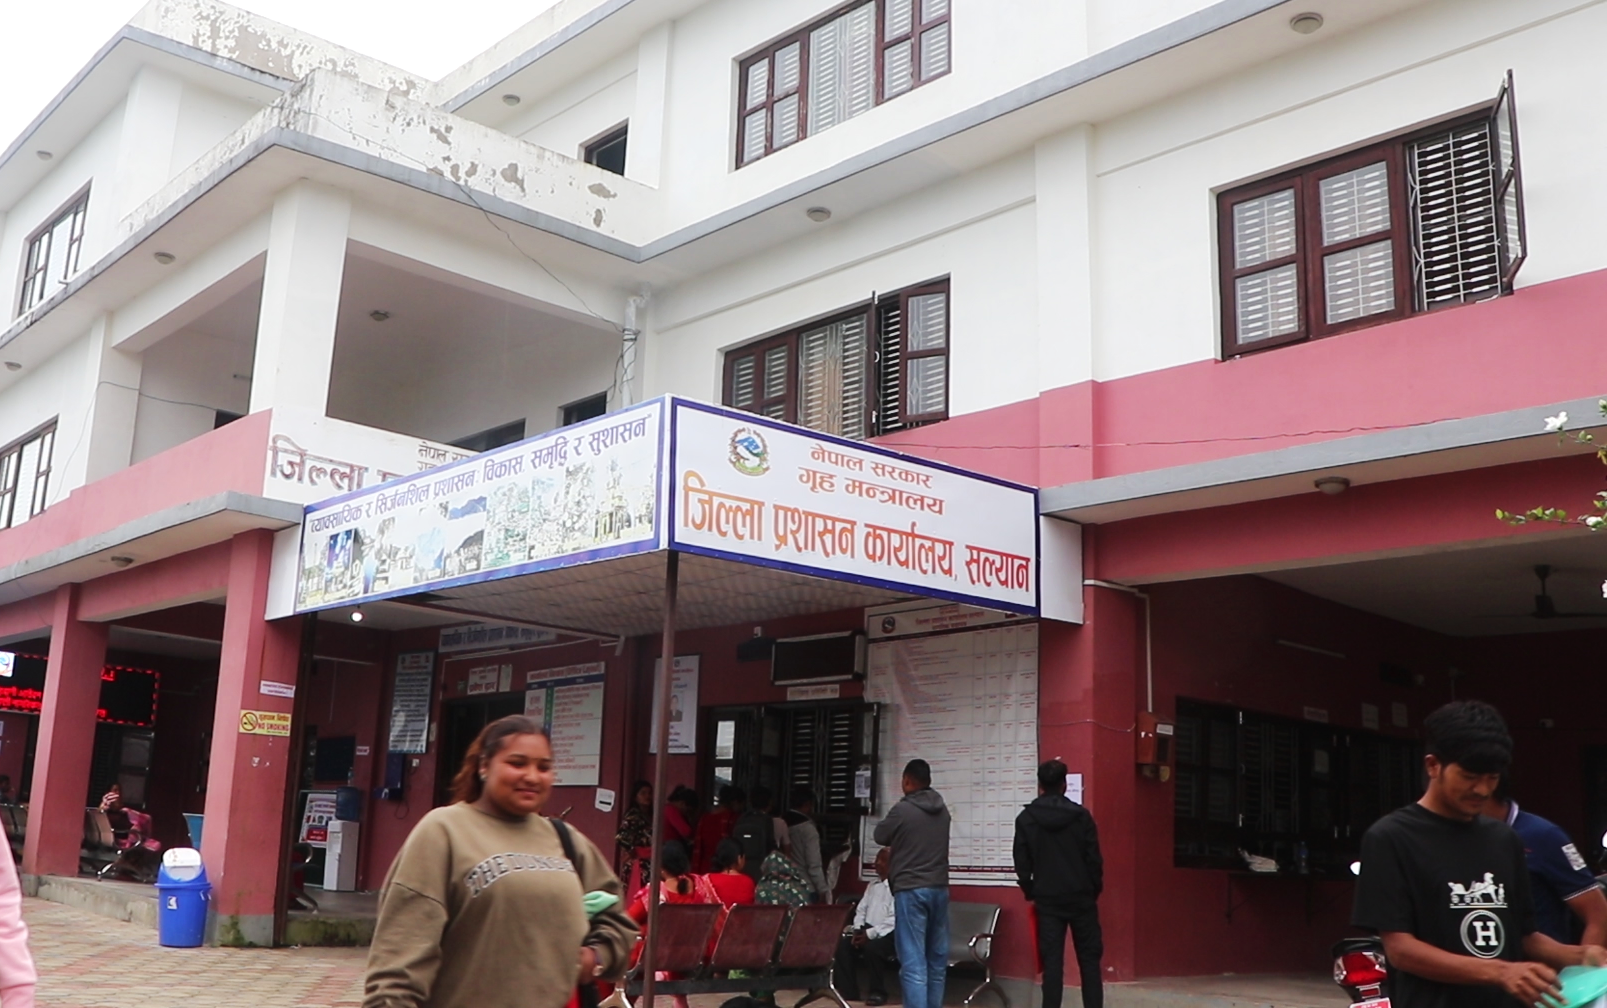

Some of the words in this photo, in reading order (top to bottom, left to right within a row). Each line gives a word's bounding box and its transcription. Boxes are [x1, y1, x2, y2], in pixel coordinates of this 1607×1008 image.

[268, 433, 368, 492] जिल्ला
[365, 500, 374, 519] र
[573, 435, 585, 457] र
[810, 443, 864, 472] नेपाल
[870, 461, 933, 490] सरकार
[798, 466, 836, 494] गृह
[845, 478, 945, 516] मन्त्रालय
[683, 470, 765, 542] जिल्ला
[773, 504, 858, 559] प्रशासन
[965, 543, 1031, 592] सल्यान
[258, 722, 265, 730] NO
[267, 723, 289, 731] SMOKING
[1472, 921, 1499, 946] H
